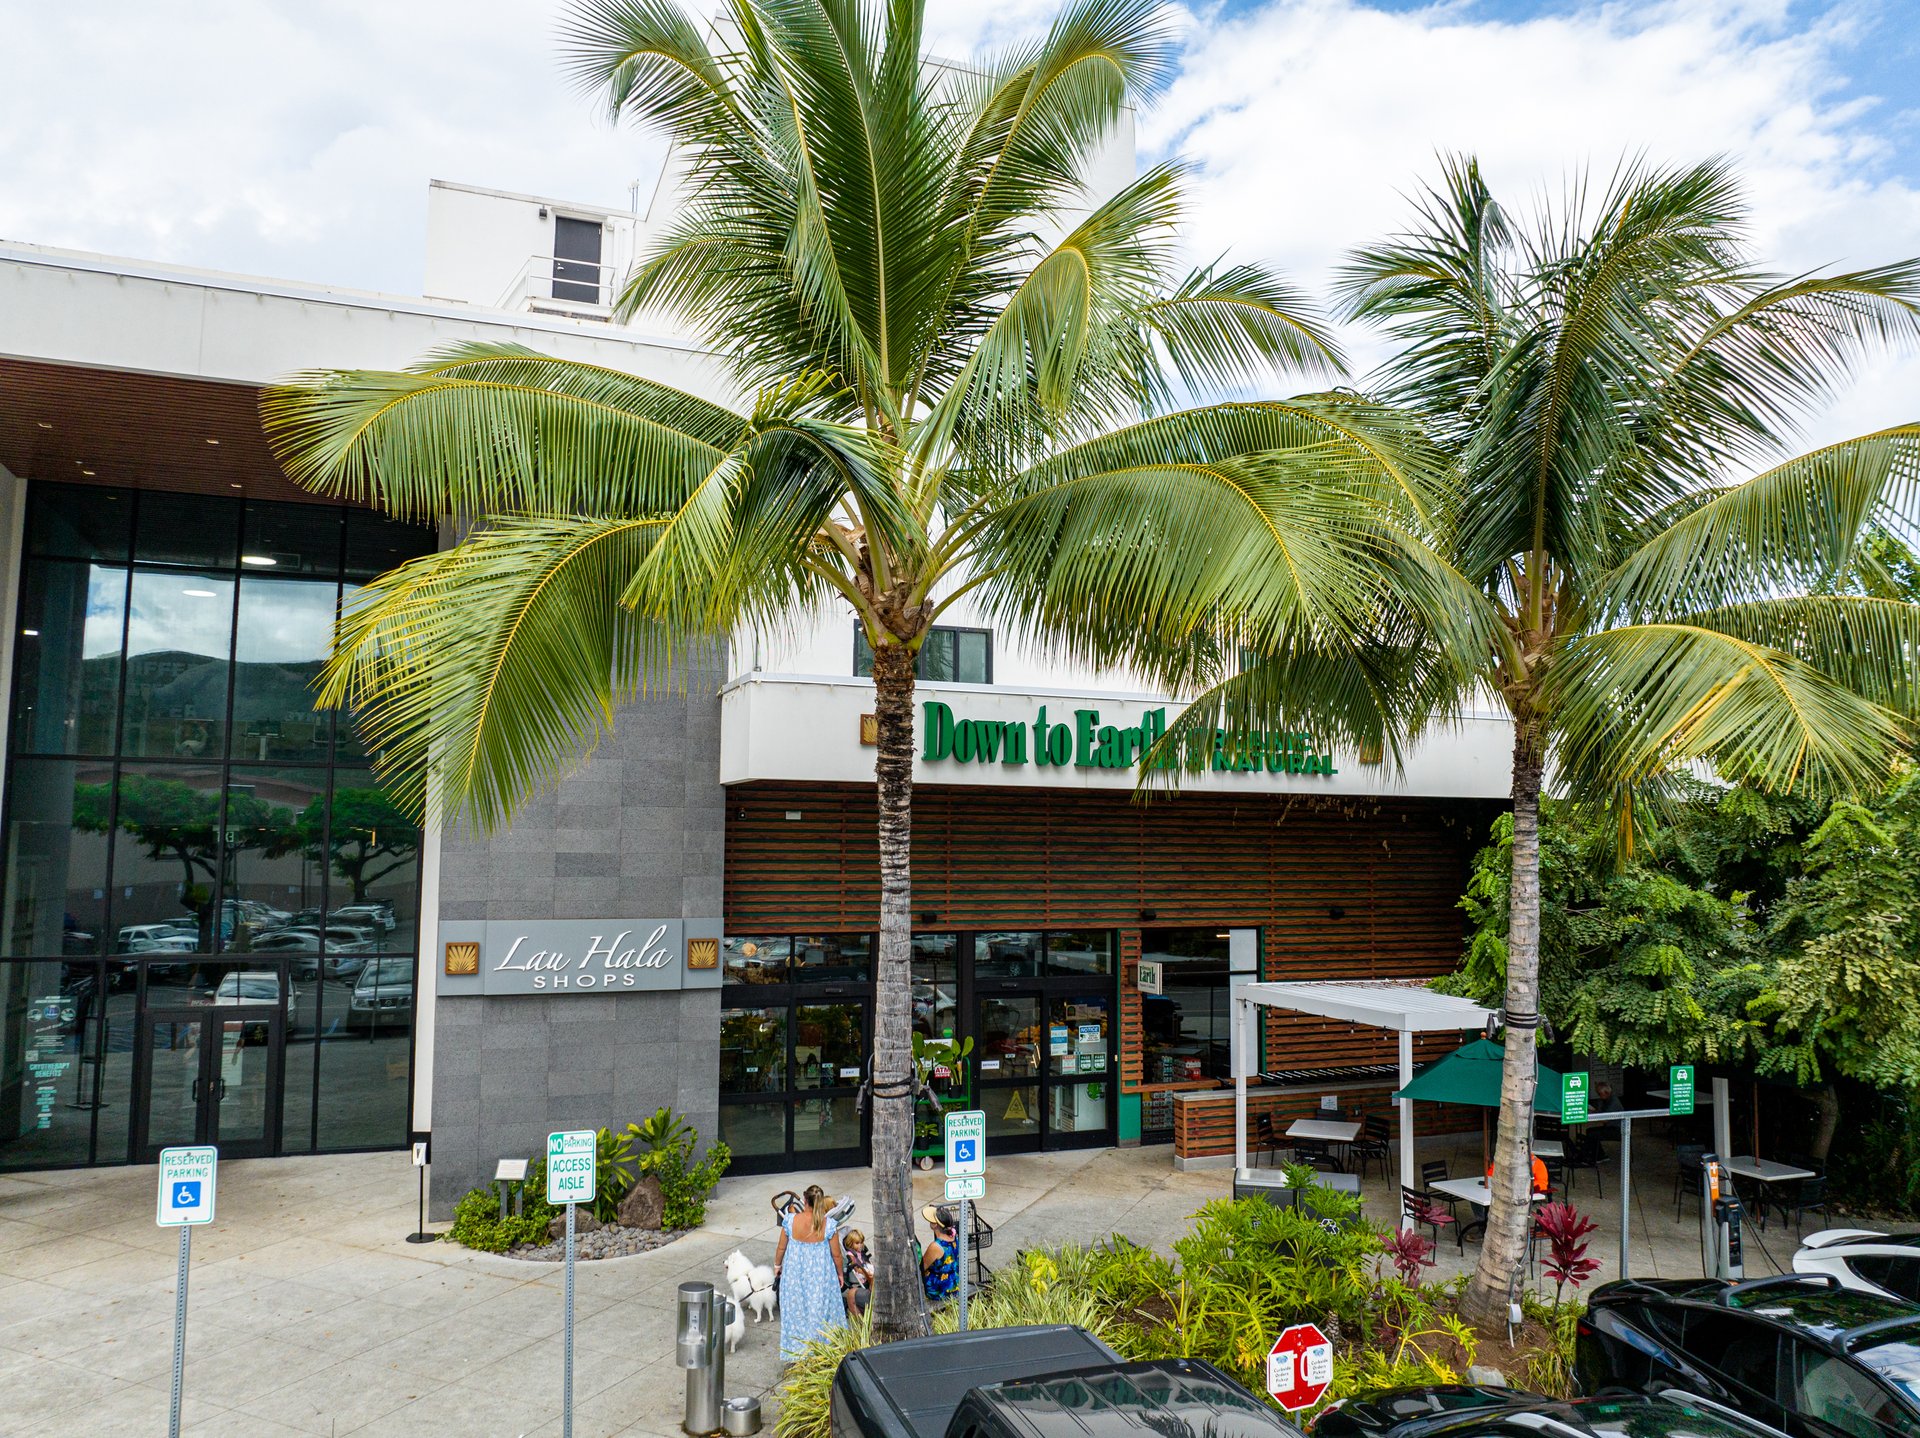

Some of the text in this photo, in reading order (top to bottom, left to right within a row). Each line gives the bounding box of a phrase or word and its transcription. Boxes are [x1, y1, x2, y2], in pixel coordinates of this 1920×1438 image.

[921, 701, 1028, 764] Down
[1032, 705, 1073, 767] to
[1212, 751, 1339, 775] NATURAL
[493, 924, 674, 972] Lau Hala
[533, 973, 635, 989] SHOPS
[948, 1117, 982, 1127] RESERVED
[950, 1128, 980, 1137] PARKING
[550, 1138, 592, 1152] NO PARKING
[165, 1154, 212, 1165] RESERVED
[552, 1157, 591, 1172] ACCESS
[167, 1167, 209, 1178] PARKING
[558, 1176, 585, 1190] AISLE
